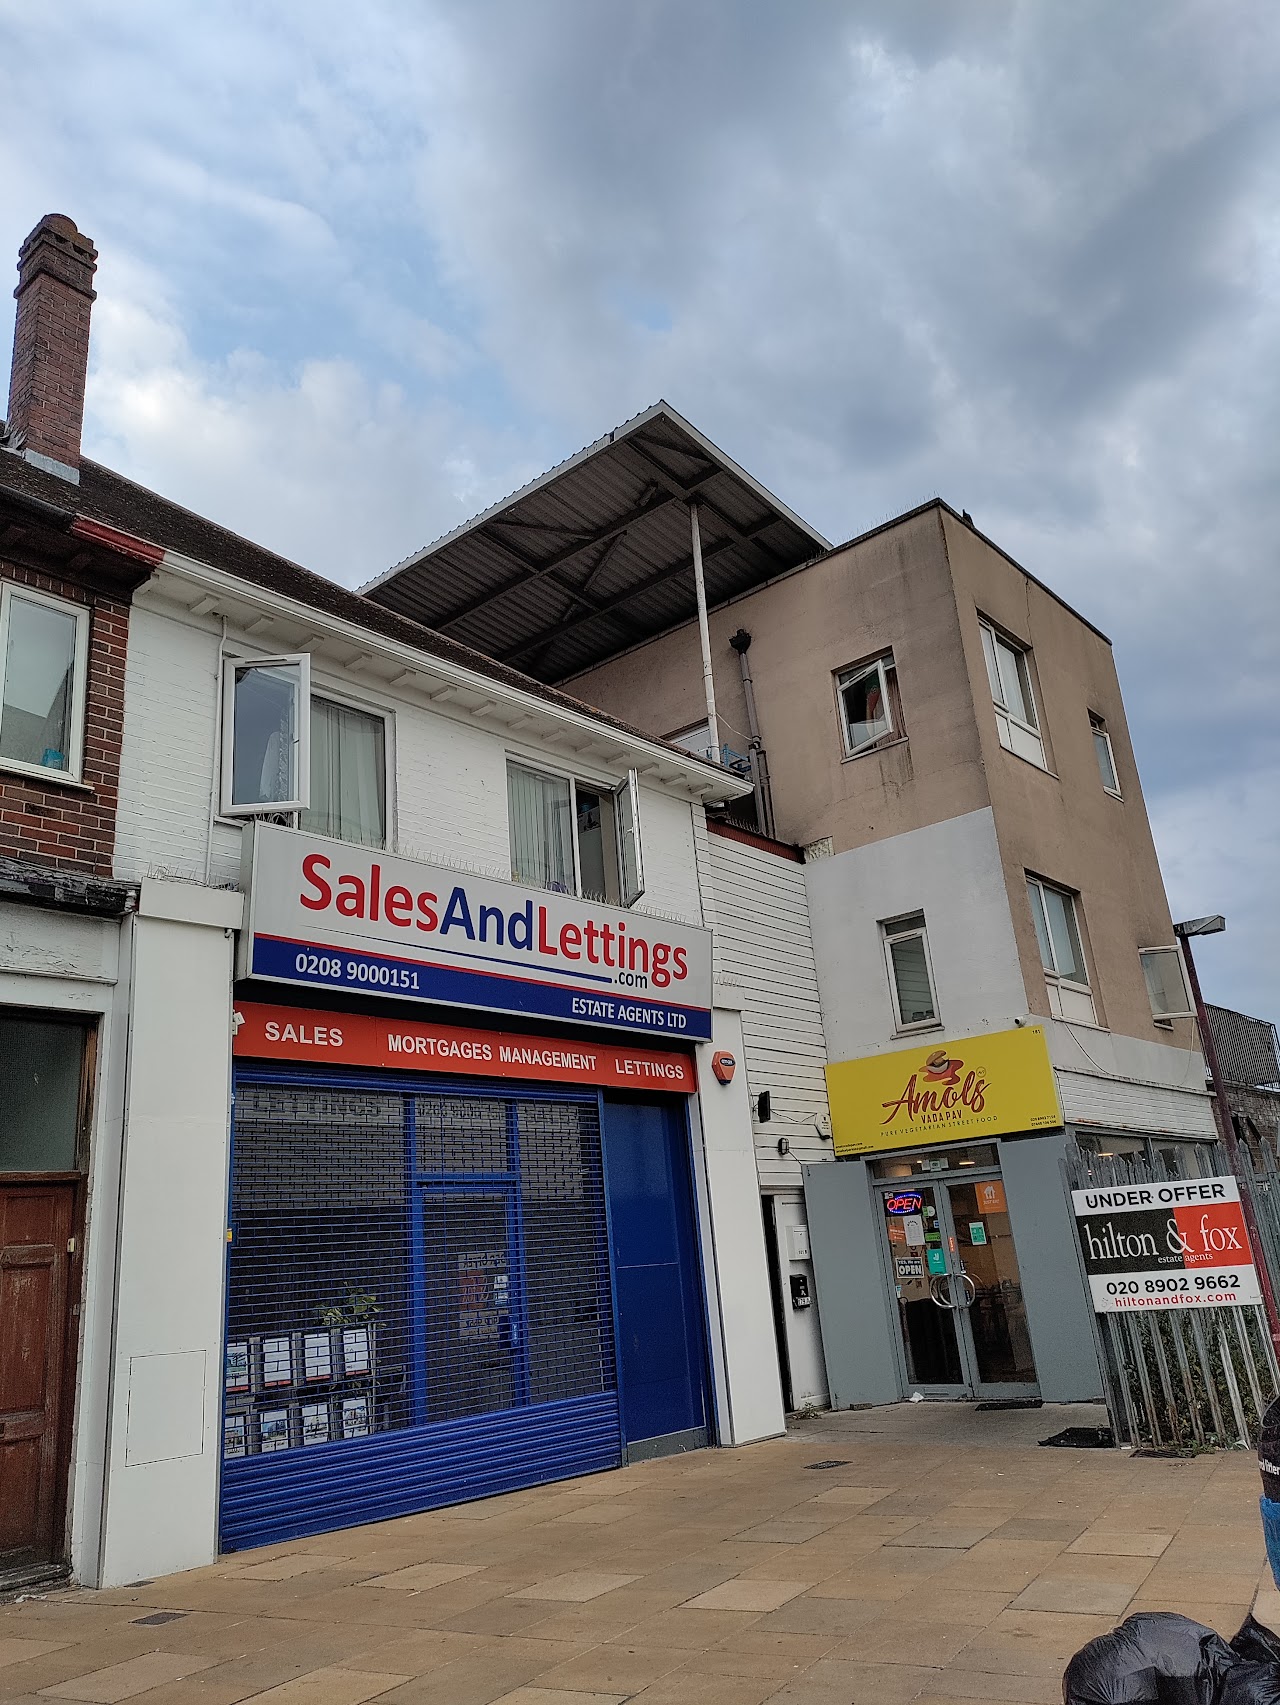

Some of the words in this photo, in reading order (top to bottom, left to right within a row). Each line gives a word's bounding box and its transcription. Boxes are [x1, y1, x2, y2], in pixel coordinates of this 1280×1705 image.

[300, 853, 688, 988] SalesAndLettings
[295, 953, 341, 977] 0208
[346, 962, 419, 990] 9000151
[614, 971, 648, 989] .com
[571, 997, 615, 1019] ESTATE
[618, 1005, 664, 1025] AGENTS
[667, 1012, 687, 1029] LTD
[264, 1021, 343, 1047] SALES
[388, 1033, 492, 1062] MORTGAGES
[499, 1046, 597, 1072] MANAGEMENT
[615, 1058, 684, 1080] LETTINGS
[900, 1123, 946, 1134] VEGETARIAN
[949, 1118, 974, 1128] STREET
[976, 1115, 998, 1123] FOOD
[921, 1113, 944, 1124] VADA
[946, 1109, 962, 1120] PAV
[886, 1198, 923, 1211] OPEN
[1085, 1190, 1153, 1209] UNDER
[1158, 1184, 1226, 1203] OFFER
[1084, 1222, 1159, 1260] hilton
[1166, 1218, 1195, 1254] &
[1200, 1214, 1243, 1252] fox
[1158, 1254, 1183, 1264] estate
[1184, 1252, 1213, 1263] agents
[899, 1264, 921, 1275] OPEN
[1106, 1281, 1139, 1295] 020
[1145, 1277, 1189, 1293] 8902
[1194, 1274, 1240, 1290] 9662
[1115, 1292, 1236, 1308] hiltonandfox.com
